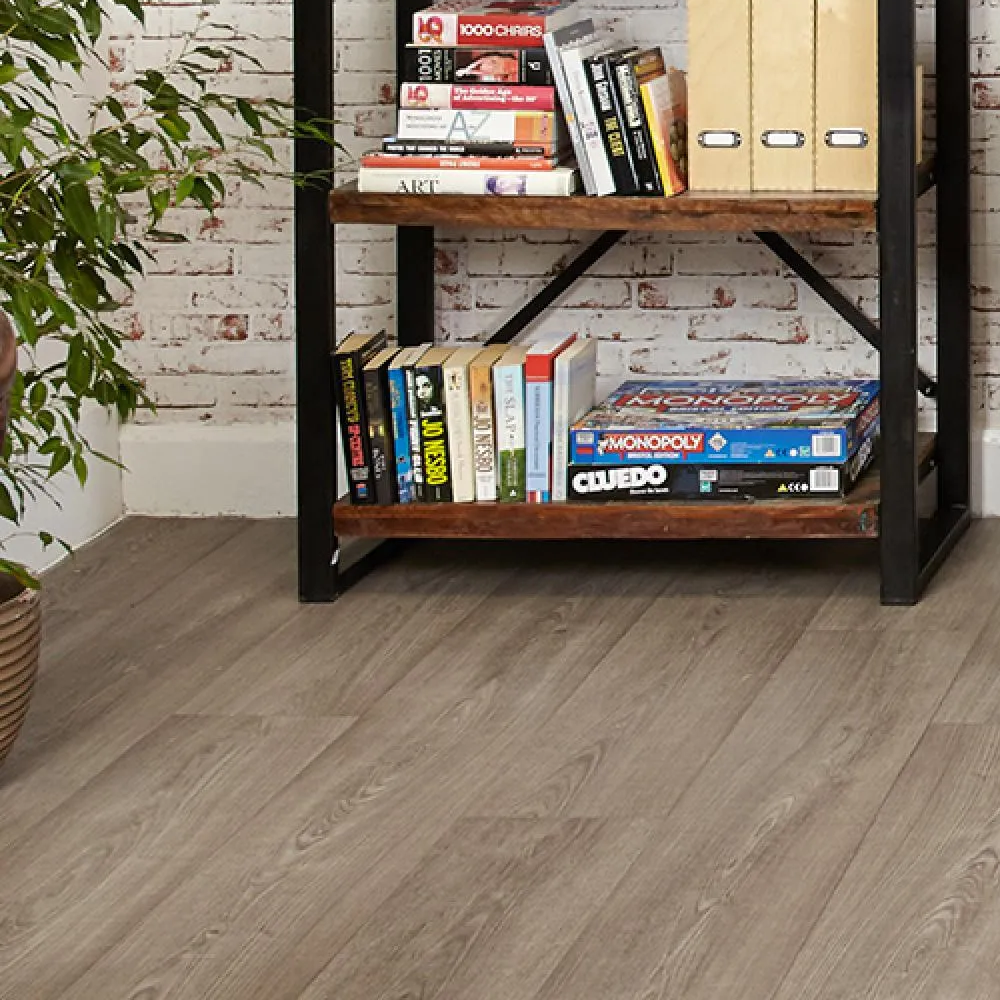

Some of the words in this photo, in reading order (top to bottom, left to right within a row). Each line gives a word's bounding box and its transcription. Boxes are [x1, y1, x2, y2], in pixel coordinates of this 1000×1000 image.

[459, 23, 493, 37] 1000
[495, 23, 543, 38] CHAIRS
[398, 179, 441, 193] ART
[626, 391, 850, 407] MONOPOLY
[421, 419, 444, 438] JO
[608, 434, 701, 450] MONOPOLY
[572, 464, 667, 493] CLUEDO
